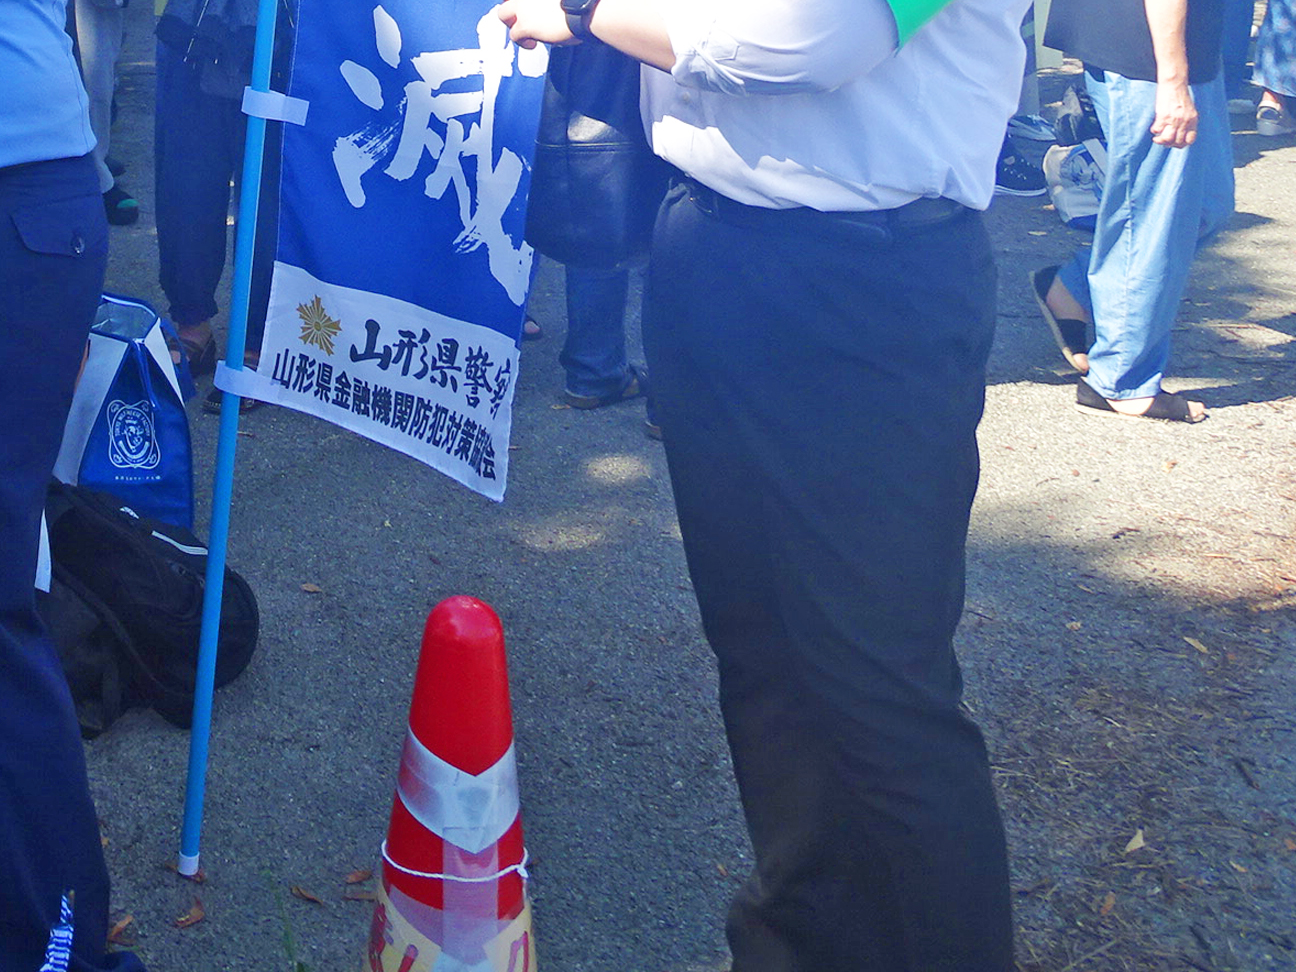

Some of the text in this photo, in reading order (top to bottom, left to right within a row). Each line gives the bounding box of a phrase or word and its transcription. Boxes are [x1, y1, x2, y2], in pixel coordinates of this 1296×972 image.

[349, 319, 511, 420] 山形県警察
